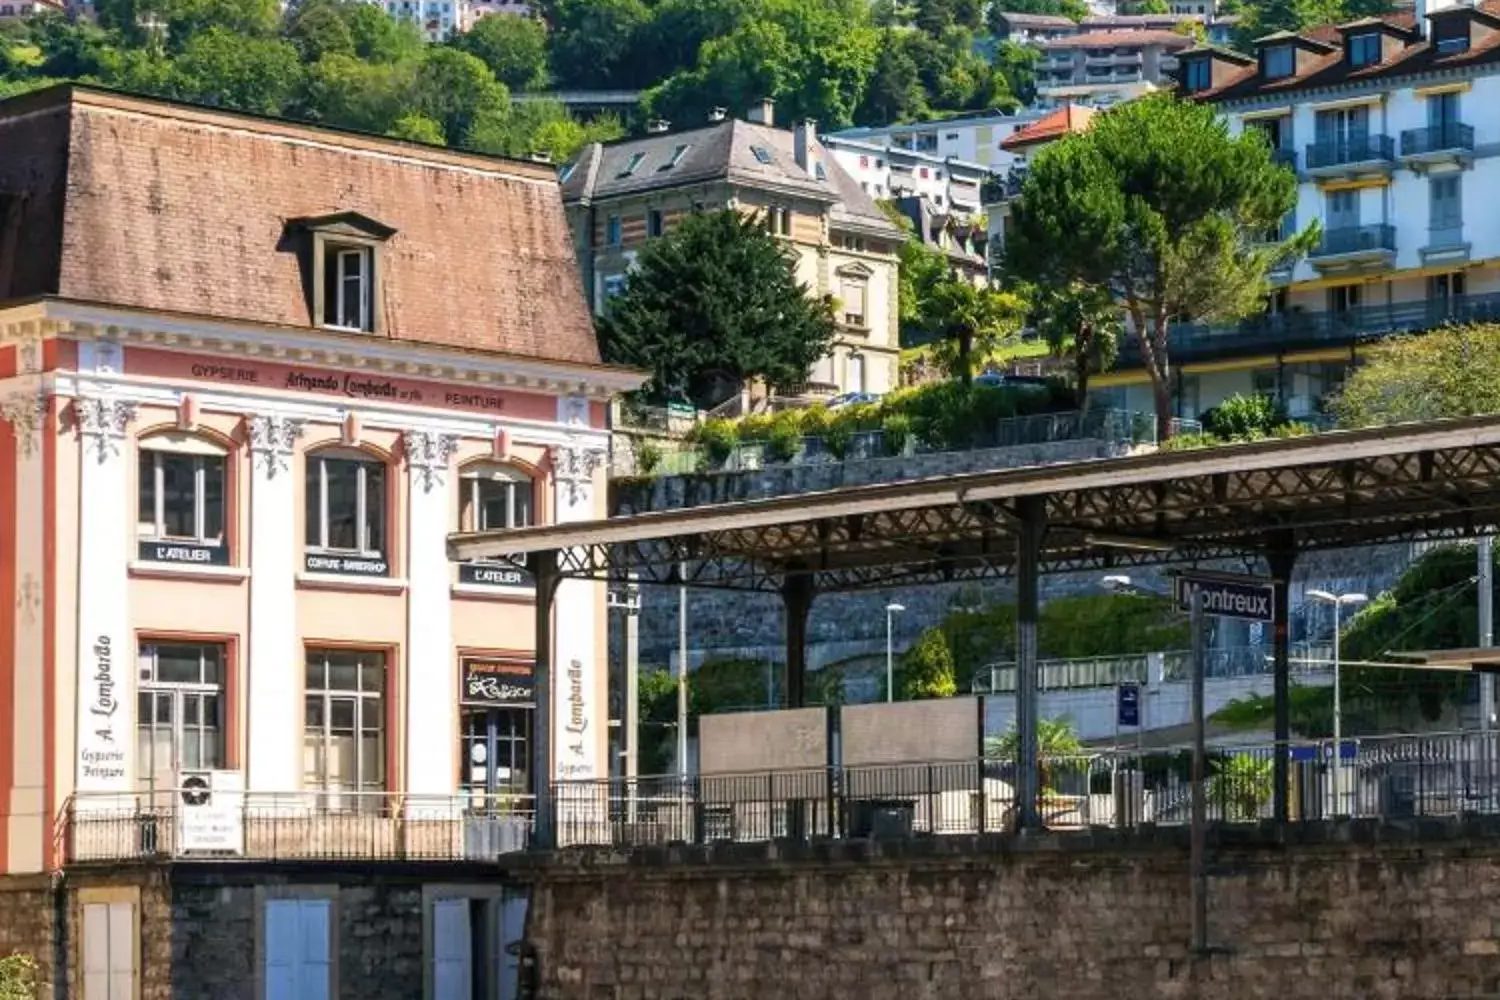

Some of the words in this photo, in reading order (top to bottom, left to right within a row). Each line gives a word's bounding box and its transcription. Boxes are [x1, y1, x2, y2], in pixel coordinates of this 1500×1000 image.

[191, 364, 258, 382] GYPSERIE
[444, 393, 505, 409] PEINTURE
[90, 635, 119, 717] Lombardo
